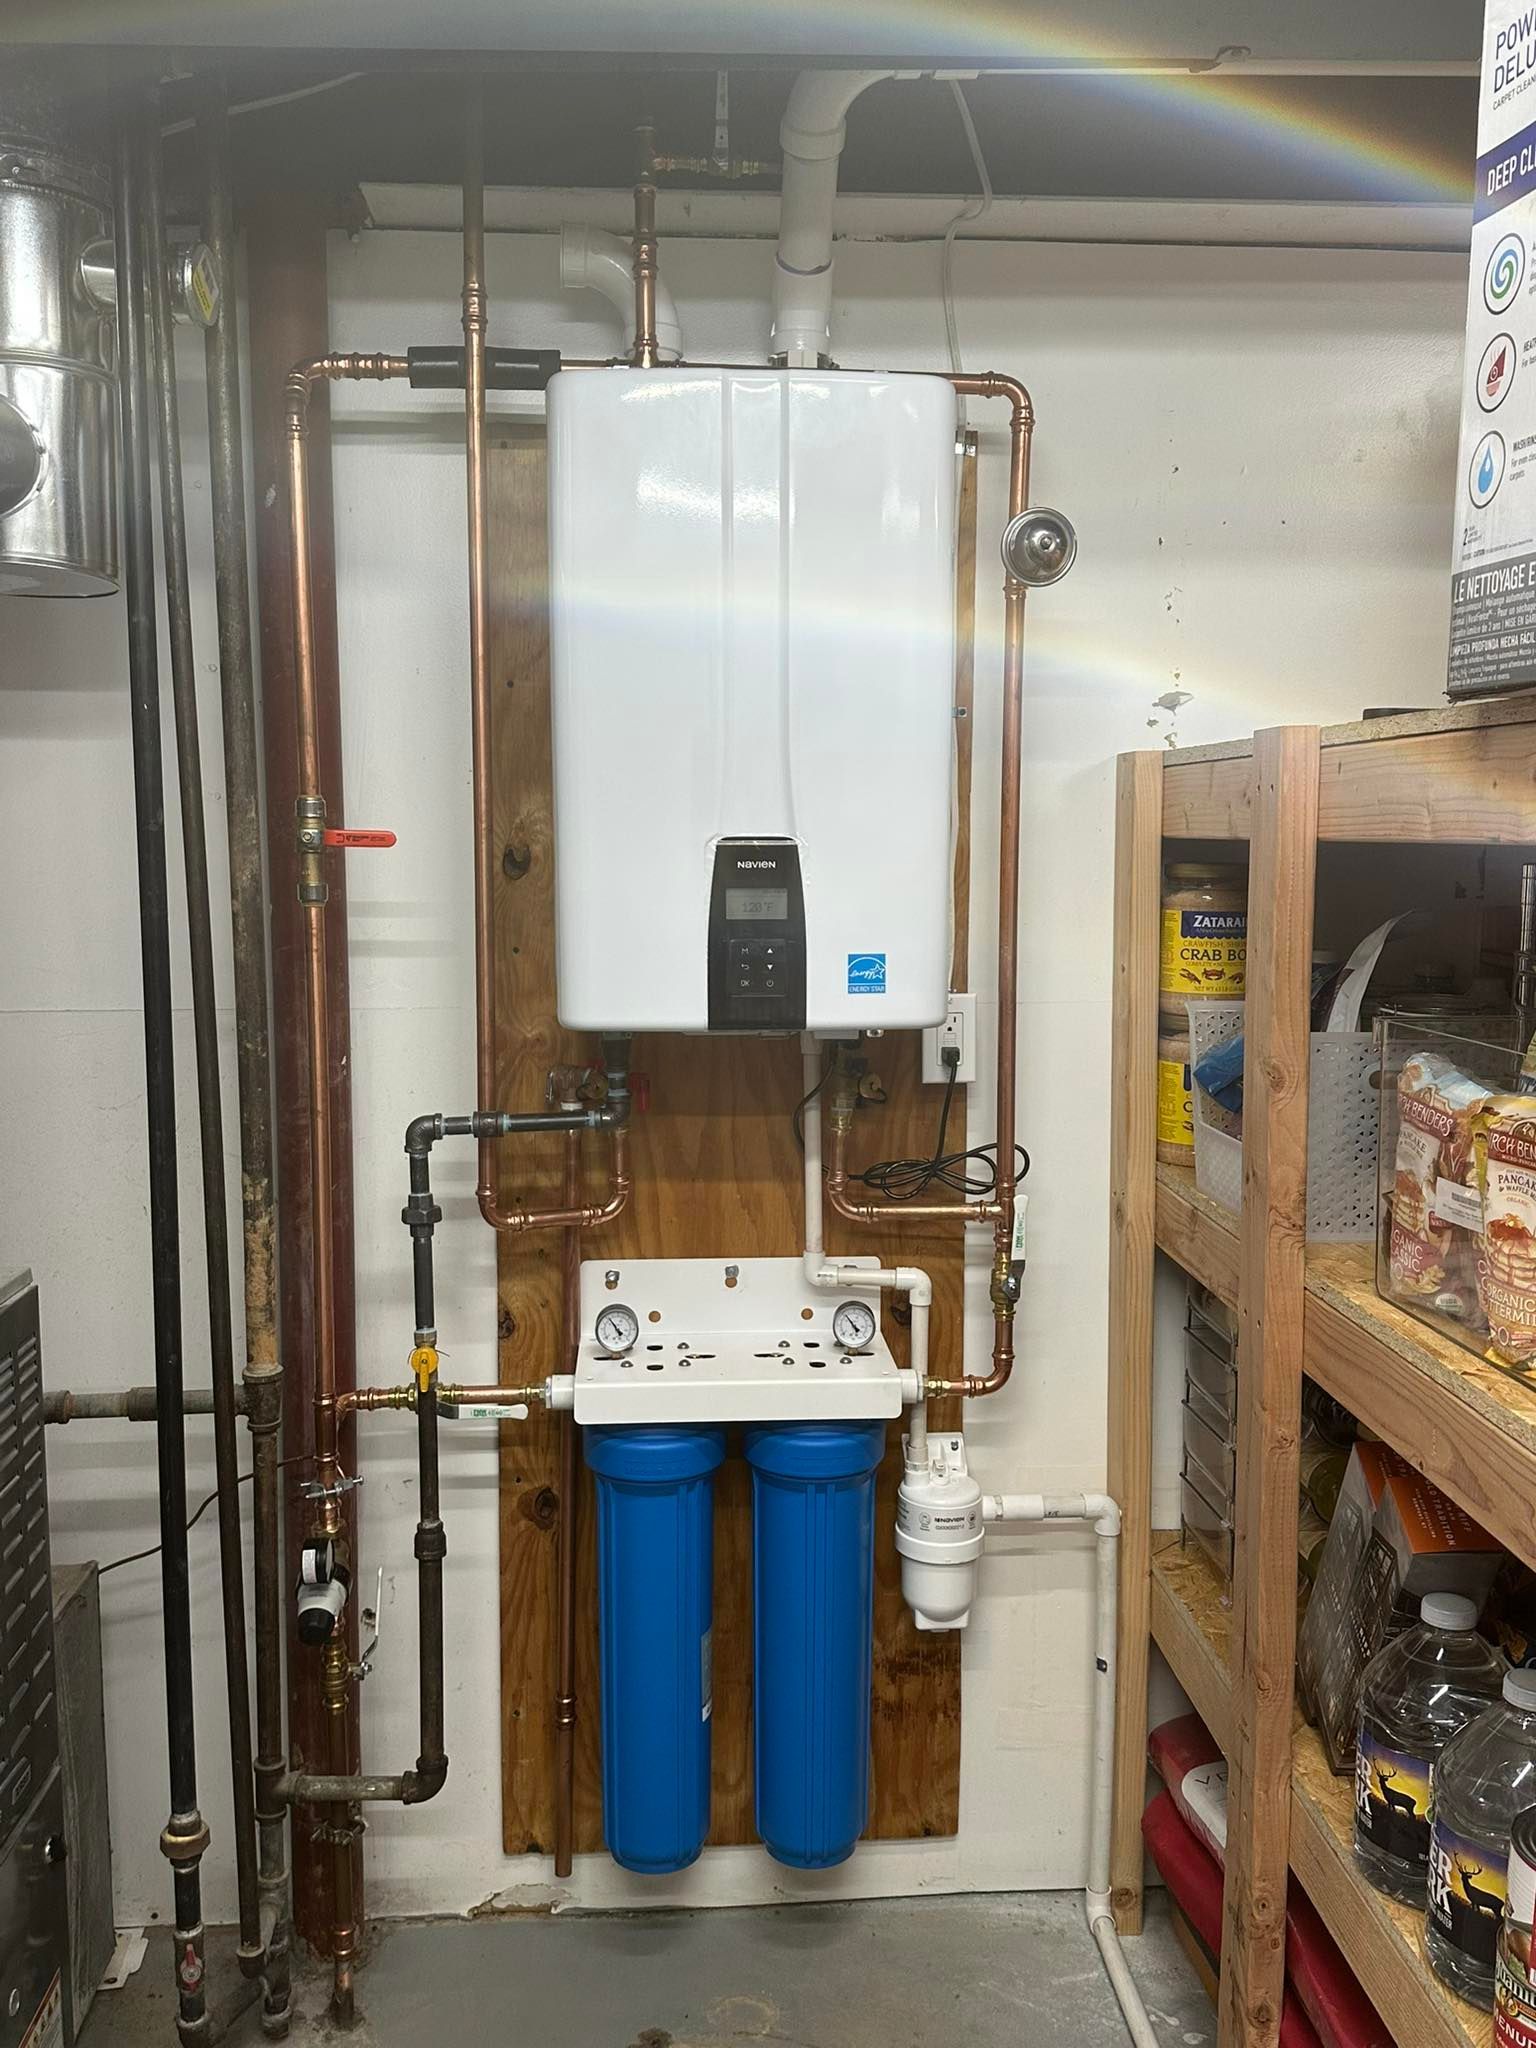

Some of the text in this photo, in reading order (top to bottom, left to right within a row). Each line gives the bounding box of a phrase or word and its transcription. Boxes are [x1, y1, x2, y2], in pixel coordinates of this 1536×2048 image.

[1496, 8, 1536, 60] POW
[1493, 88, 1515, 110] CARPET
[1487, 144, 1536, 196] DEEP CL
[1463, 527, 1468, 546] 2
[1454, 579, 1465, 603] LE
[1466, 563, 1526, 600] NETTOYAGE
[1472, 638, 1499, 653] PROFUNDA
[1180, 948, 1222, 960] CRAB
[1411, 1101, 1453, 1137] BENDERS
[1506, 1184, 1530, 1196] WAFFLE
[1487, 1283, 1536, 1312] ORGANIC
[1433, 1500, 1457, 1546] TRADITION
